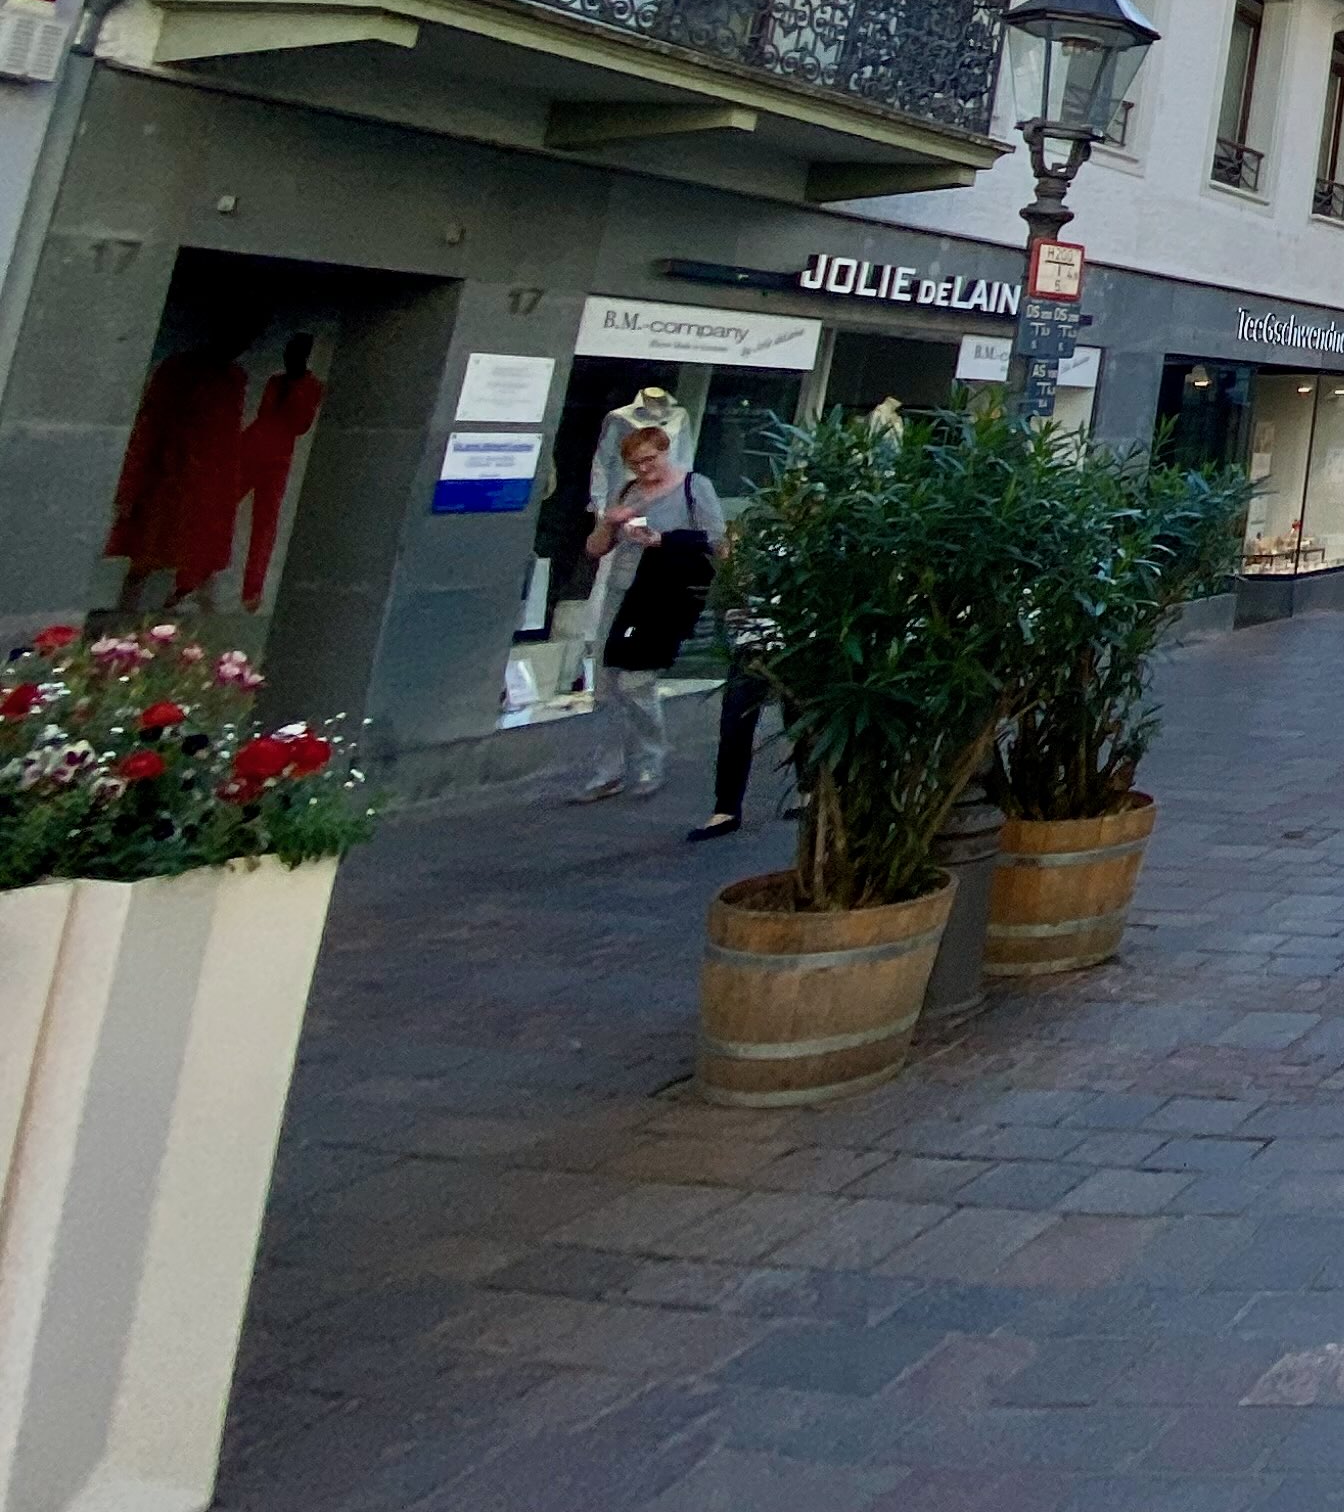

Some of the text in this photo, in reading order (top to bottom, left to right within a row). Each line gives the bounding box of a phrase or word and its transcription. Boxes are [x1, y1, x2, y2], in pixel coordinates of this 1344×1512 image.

[91, 238, 143, 275] 17
[800, 254, 916, 302] JOLIE
[508, 288, 544, 314] 17
